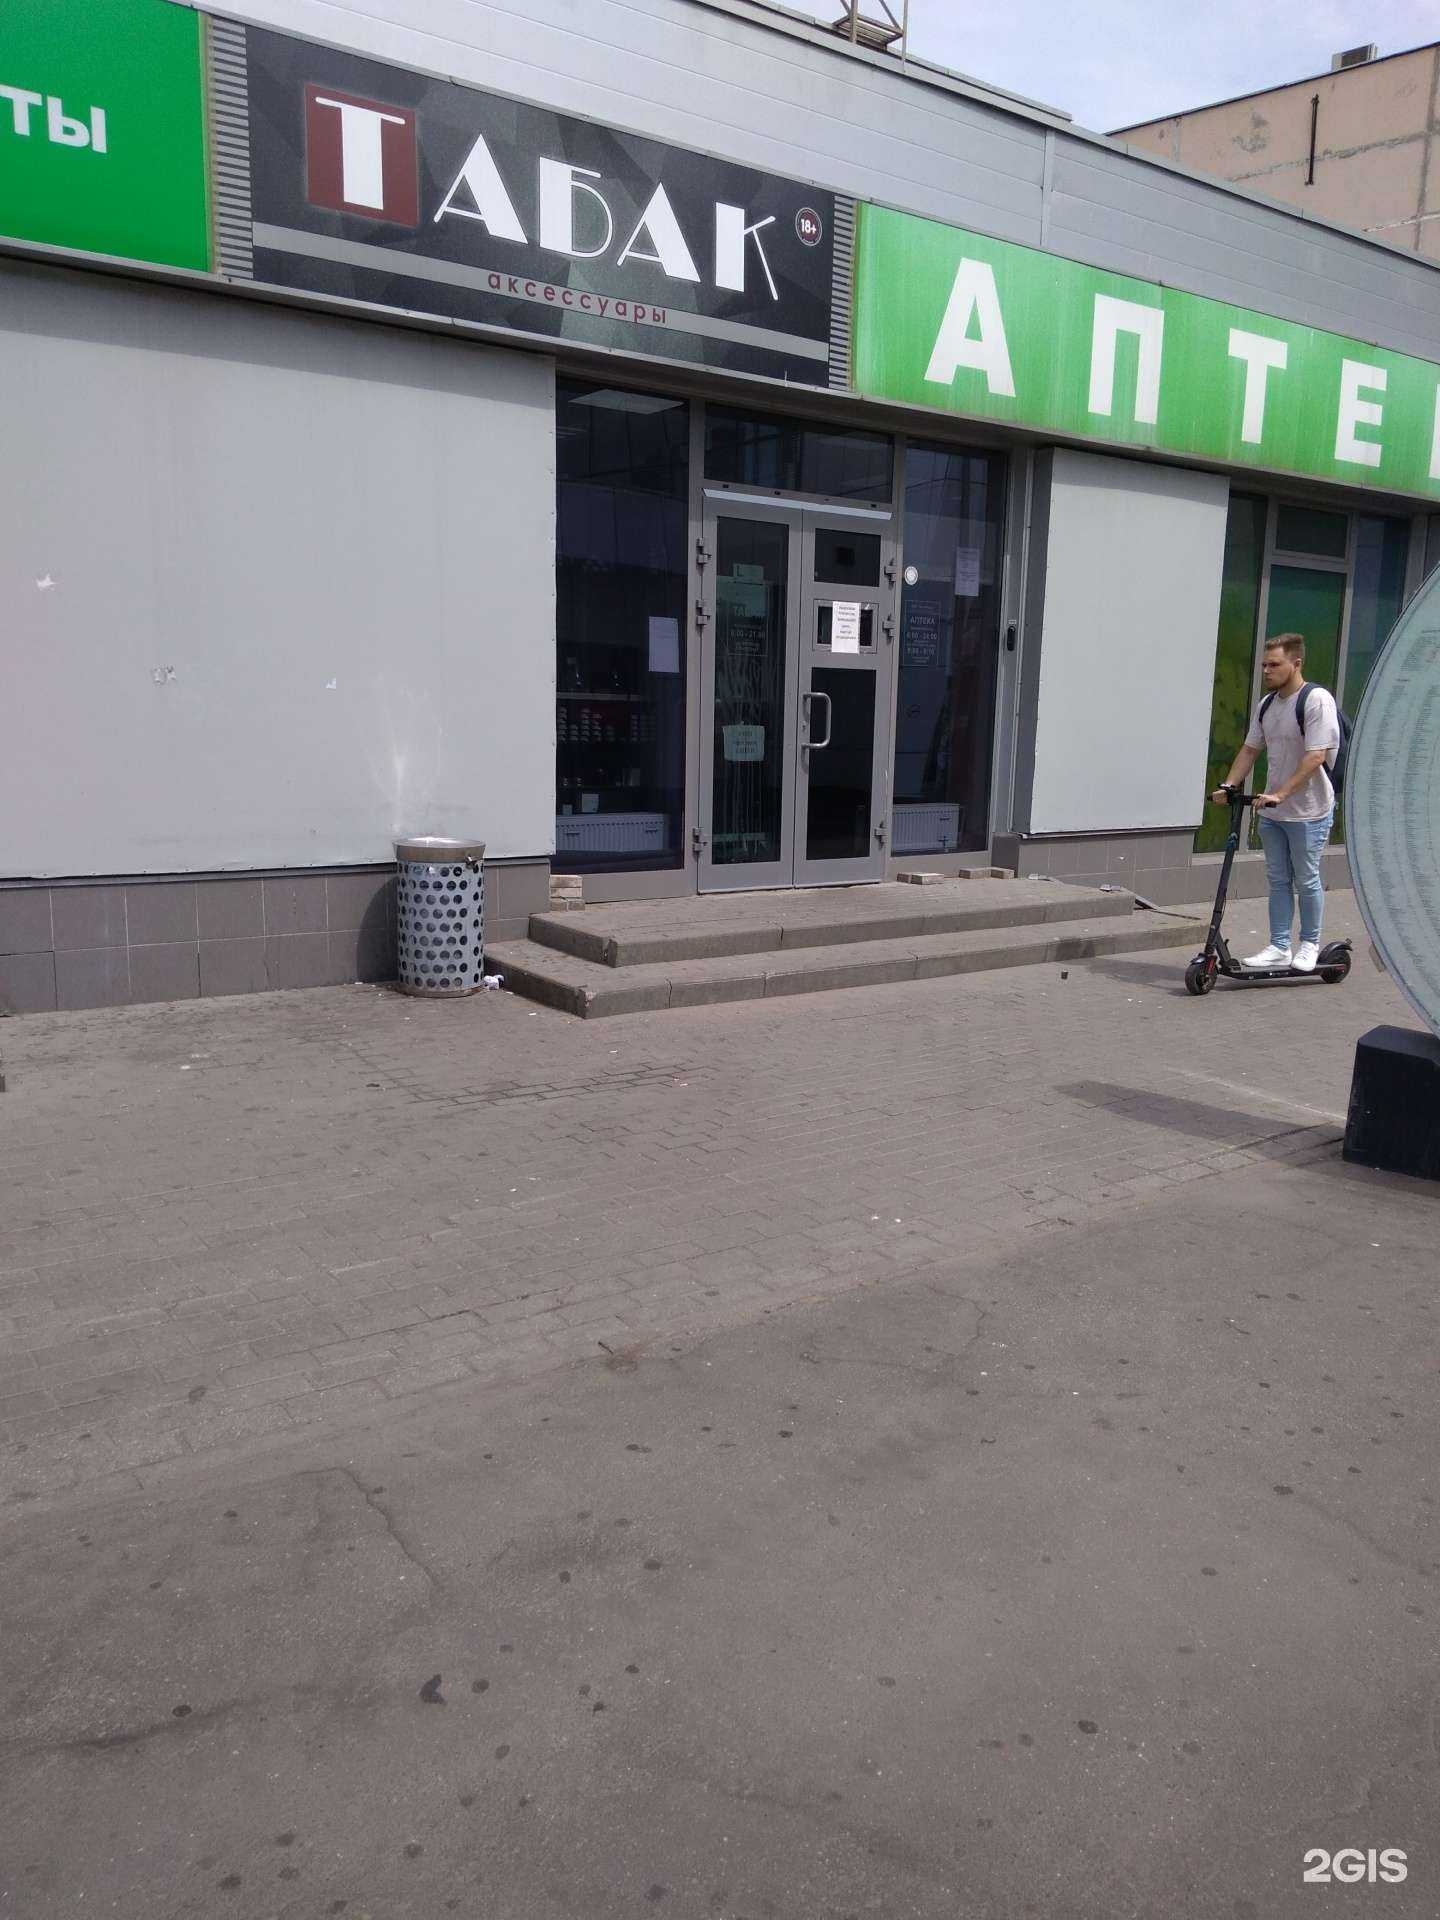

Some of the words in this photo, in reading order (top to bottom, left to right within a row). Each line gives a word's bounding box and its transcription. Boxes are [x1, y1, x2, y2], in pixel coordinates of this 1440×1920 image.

[315, 96, 779, 301] ТАБАК
[800, 218, 817, 234] 18+
[487, 272, 666, 324] аксессуары
[924, 257, 1440, 479] АПТЕ
